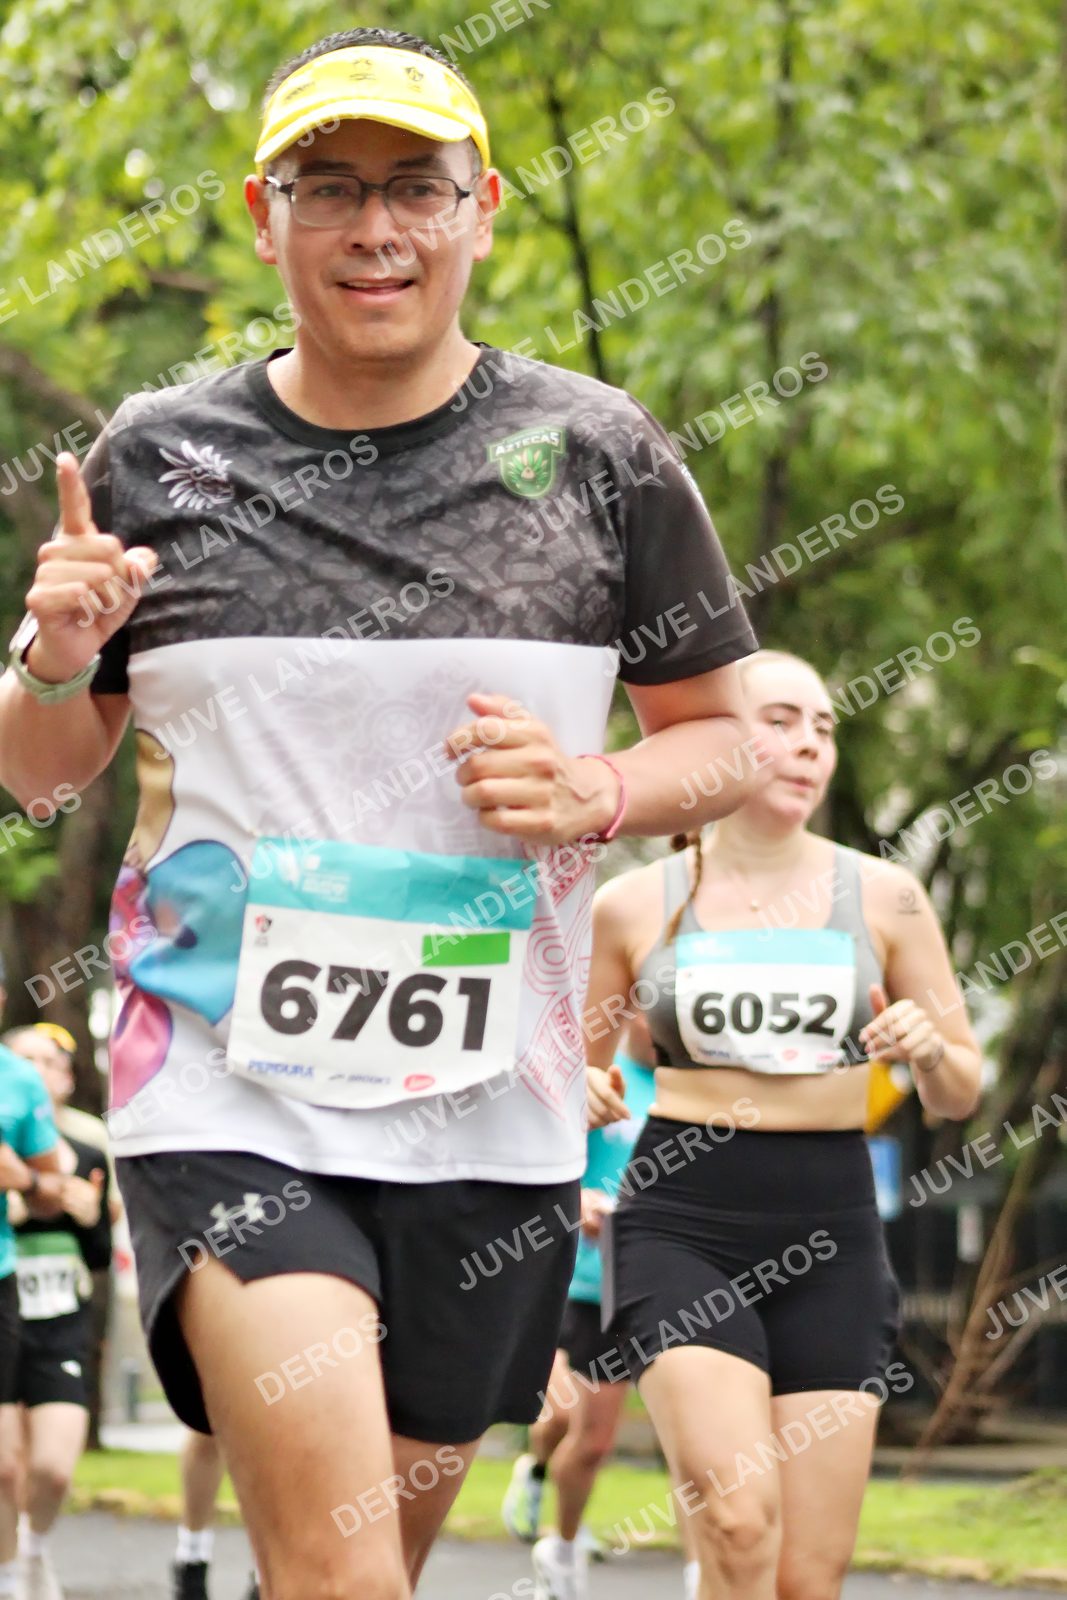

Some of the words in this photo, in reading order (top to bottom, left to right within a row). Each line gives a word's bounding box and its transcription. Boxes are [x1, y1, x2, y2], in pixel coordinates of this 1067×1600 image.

[495, 431, 560, 457] AZTECAS
[259, 959, 491, 1052] 6761
[693, 992, 837, 1037] 6052
